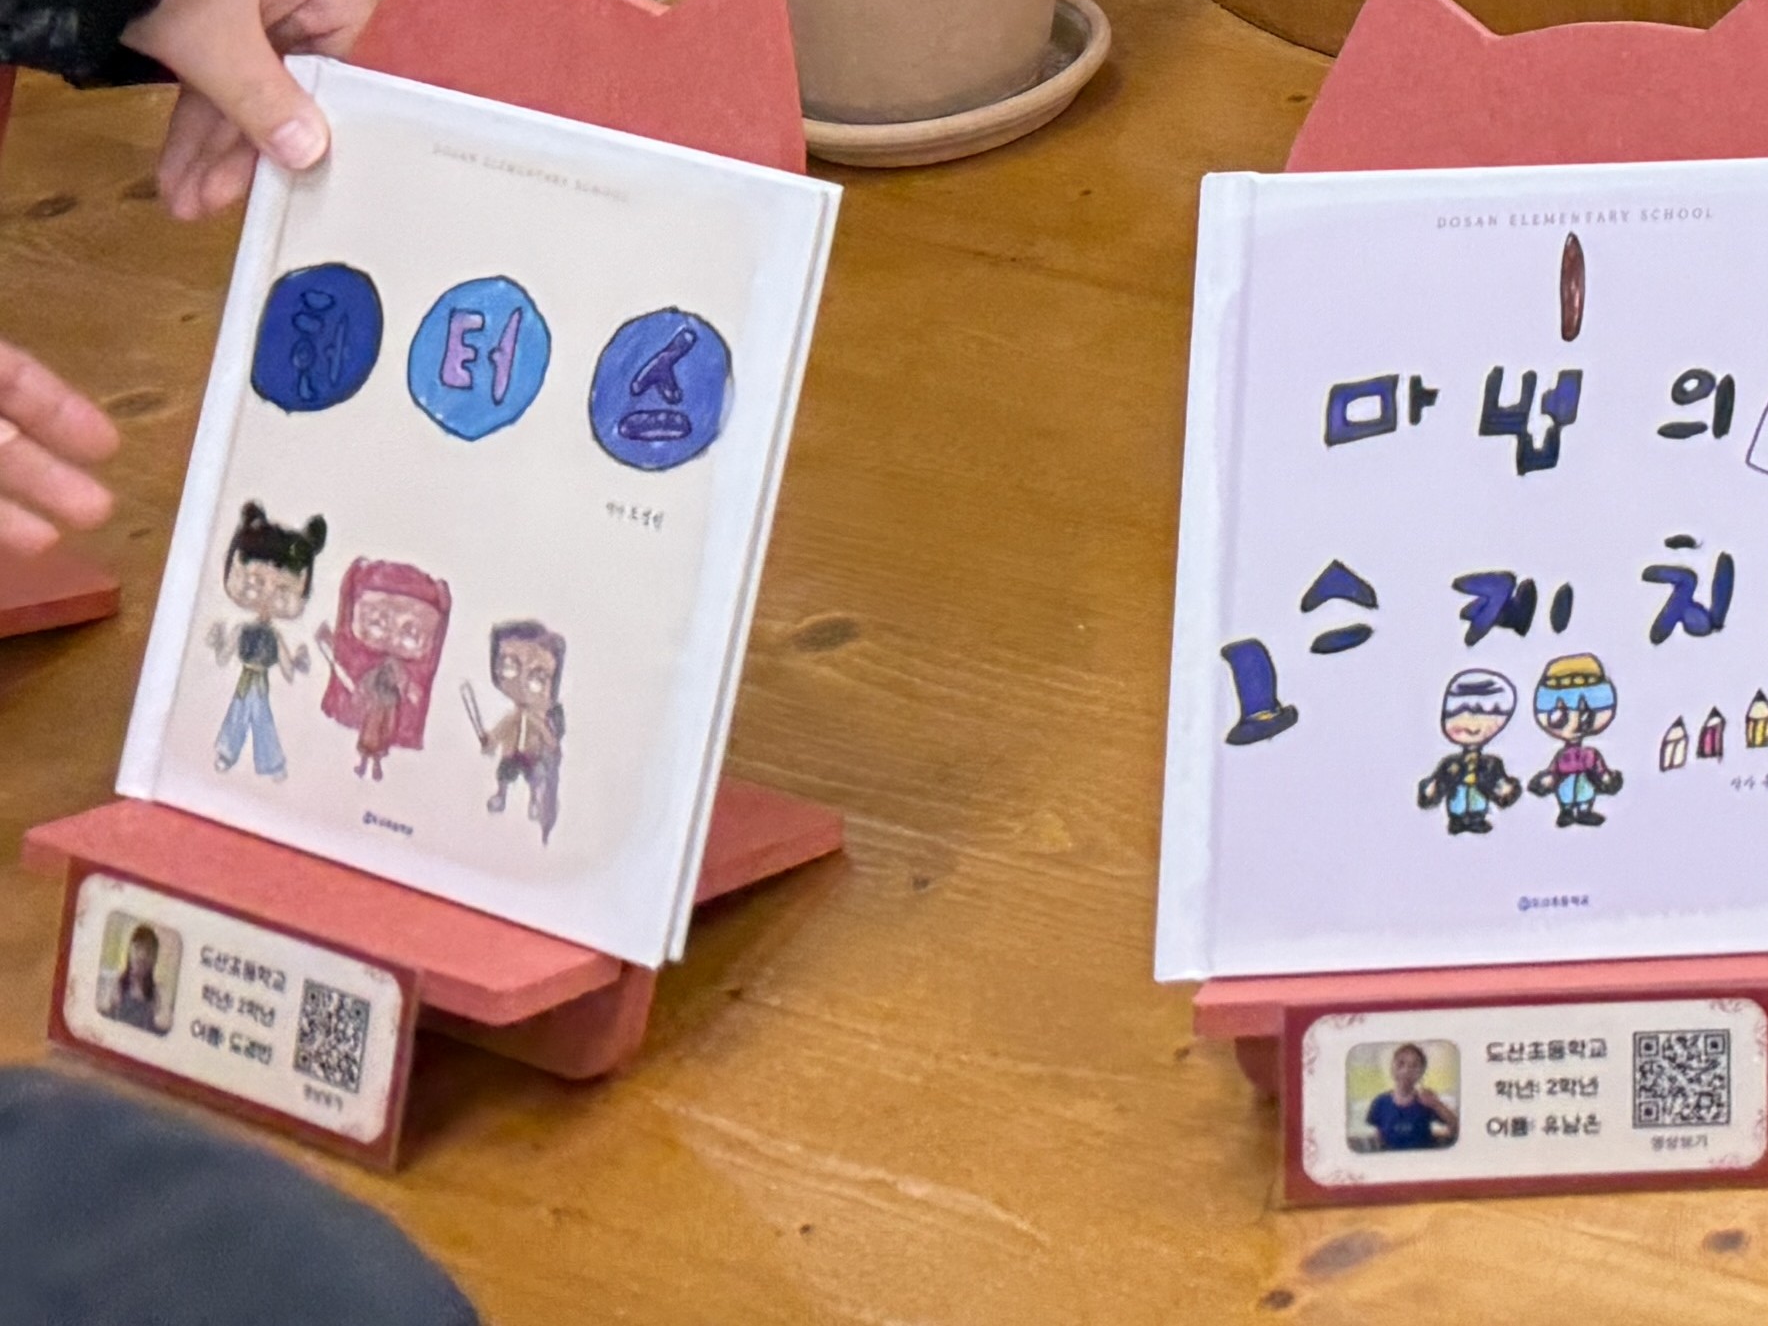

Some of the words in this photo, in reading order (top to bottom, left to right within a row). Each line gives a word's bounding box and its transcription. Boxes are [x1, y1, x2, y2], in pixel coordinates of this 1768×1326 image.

[1436, 214, 1499, 230] DOSAN
[1508, 209, 1631, 228] ELEMENTARY
[1640, 206, 1715, 223] SCHOOL
[1486, 1038, 1608, 1062] 도산초등학교
[1546, 1076, 1600, 1097] 2학년
